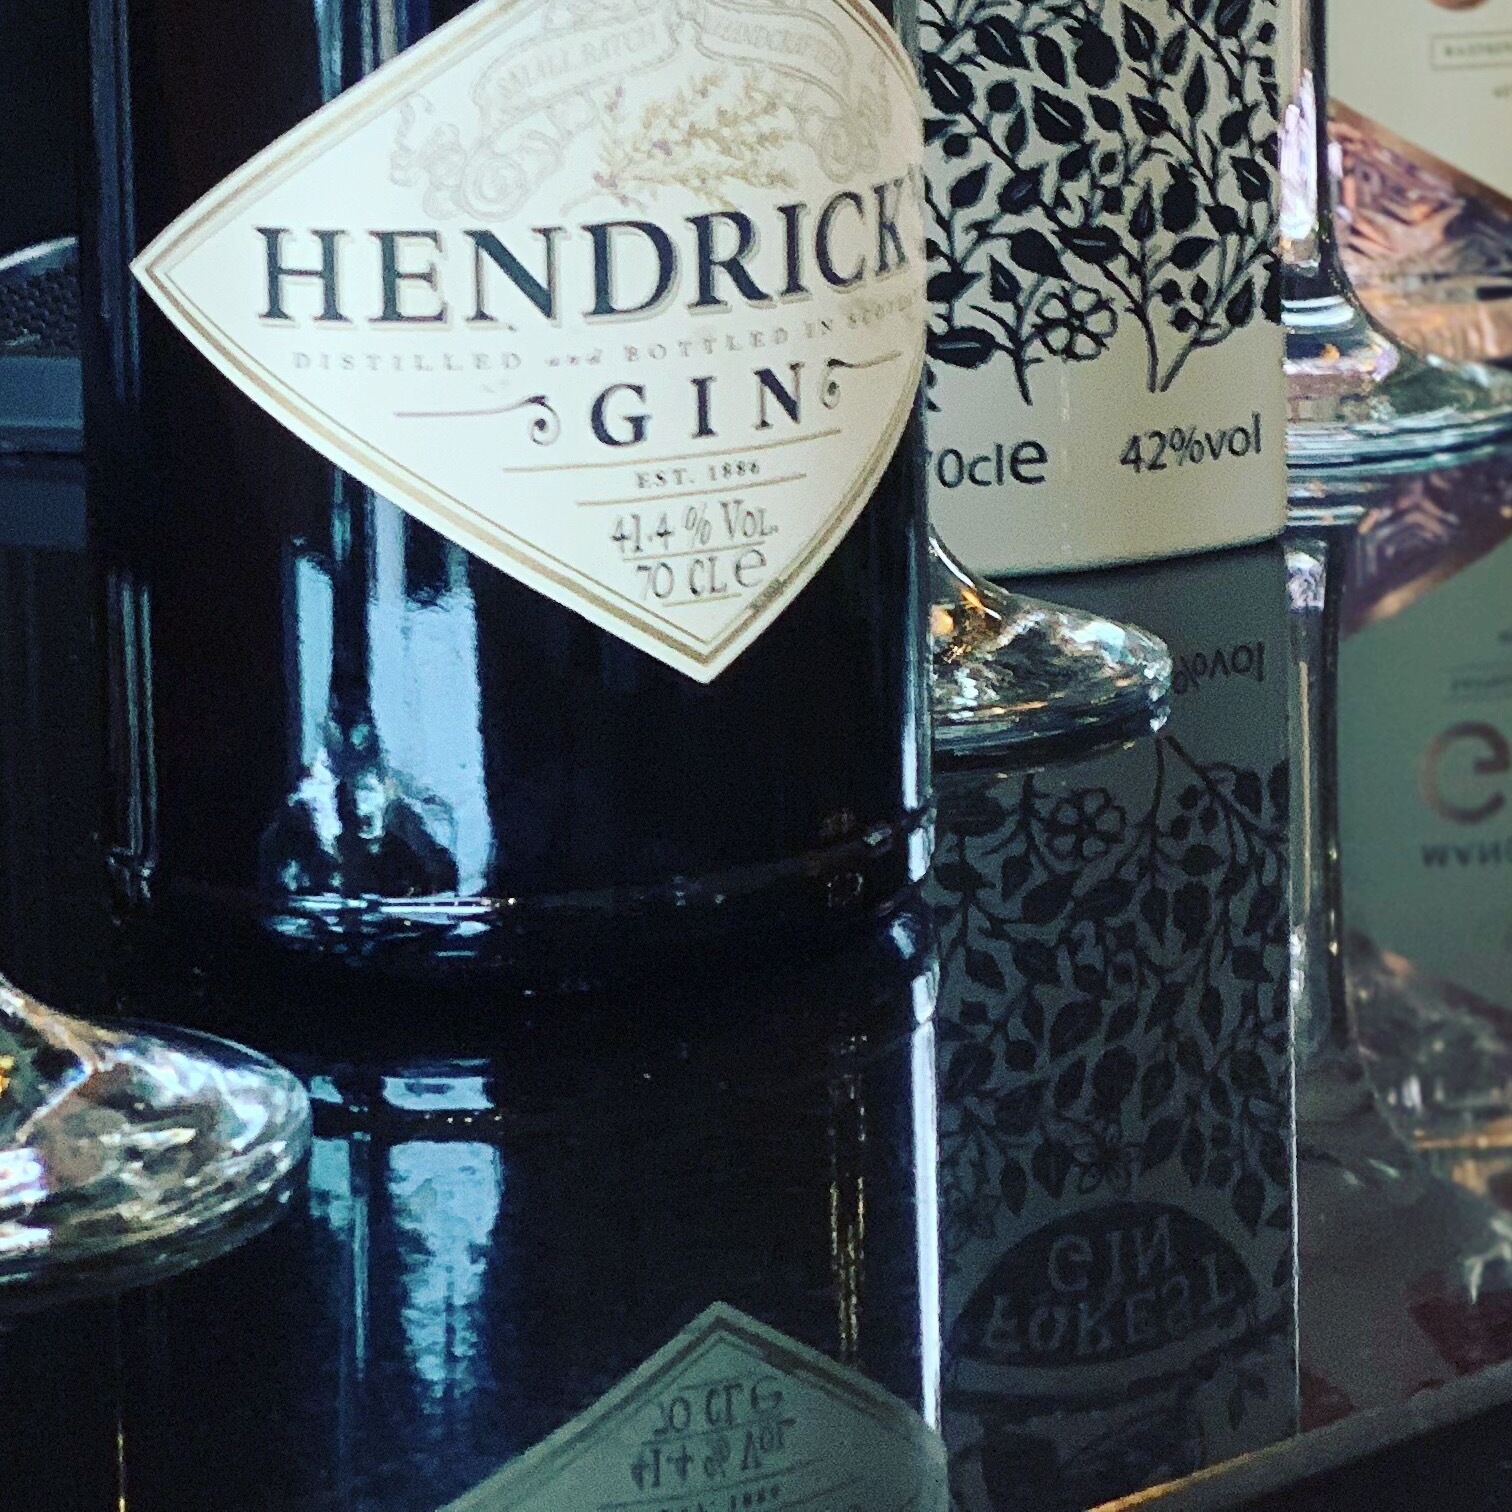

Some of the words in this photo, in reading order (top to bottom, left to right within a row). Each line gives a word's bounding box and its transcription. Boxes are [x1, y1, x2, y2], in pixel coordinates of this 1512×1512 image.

[292, 351, 522, 372] DISTILLED
[624, 327, 789, 362] BOTTLED
[590, 360, 805, 448] GIN
[636, 561, 674, 601] 70
